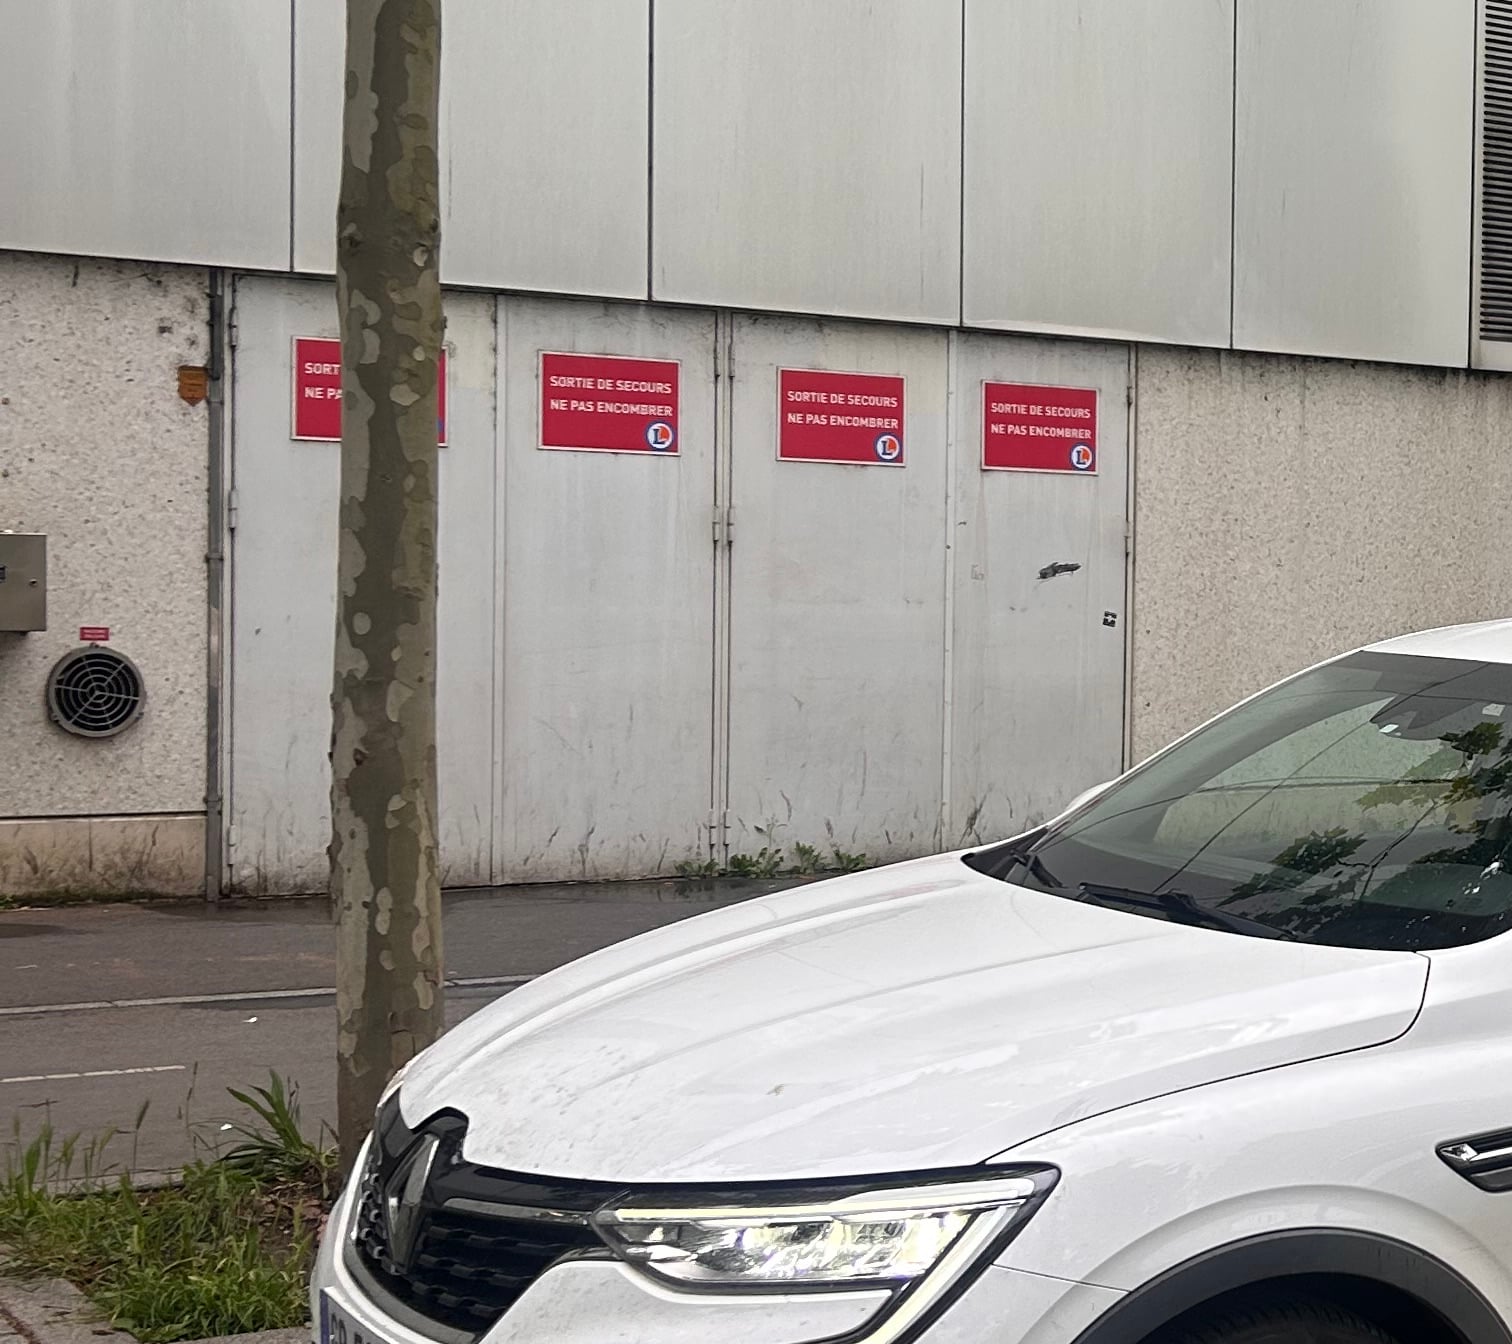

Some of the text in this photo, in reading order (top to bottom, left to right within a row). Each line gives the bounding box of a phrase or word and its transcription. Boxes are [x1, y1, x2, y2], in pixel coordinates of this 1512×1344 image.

[304, 362, 341, 375] SORT
[549, 376, 672, 394] SORTIE DE SECOURS
[304, 387, 343, 400] NE PA
[787, 391, 898, 408] SORTIE DE SECOURS
[550, 399, 673, 416] NE PAS ENCOMBRER
[991, 402, 1091, 419] SORTIE DE SECOURS
[787, 413, 898, 429] NE PAS ENCOMBRER
[991, 423, 1092, 439] NE PAS ENCOMBRER
